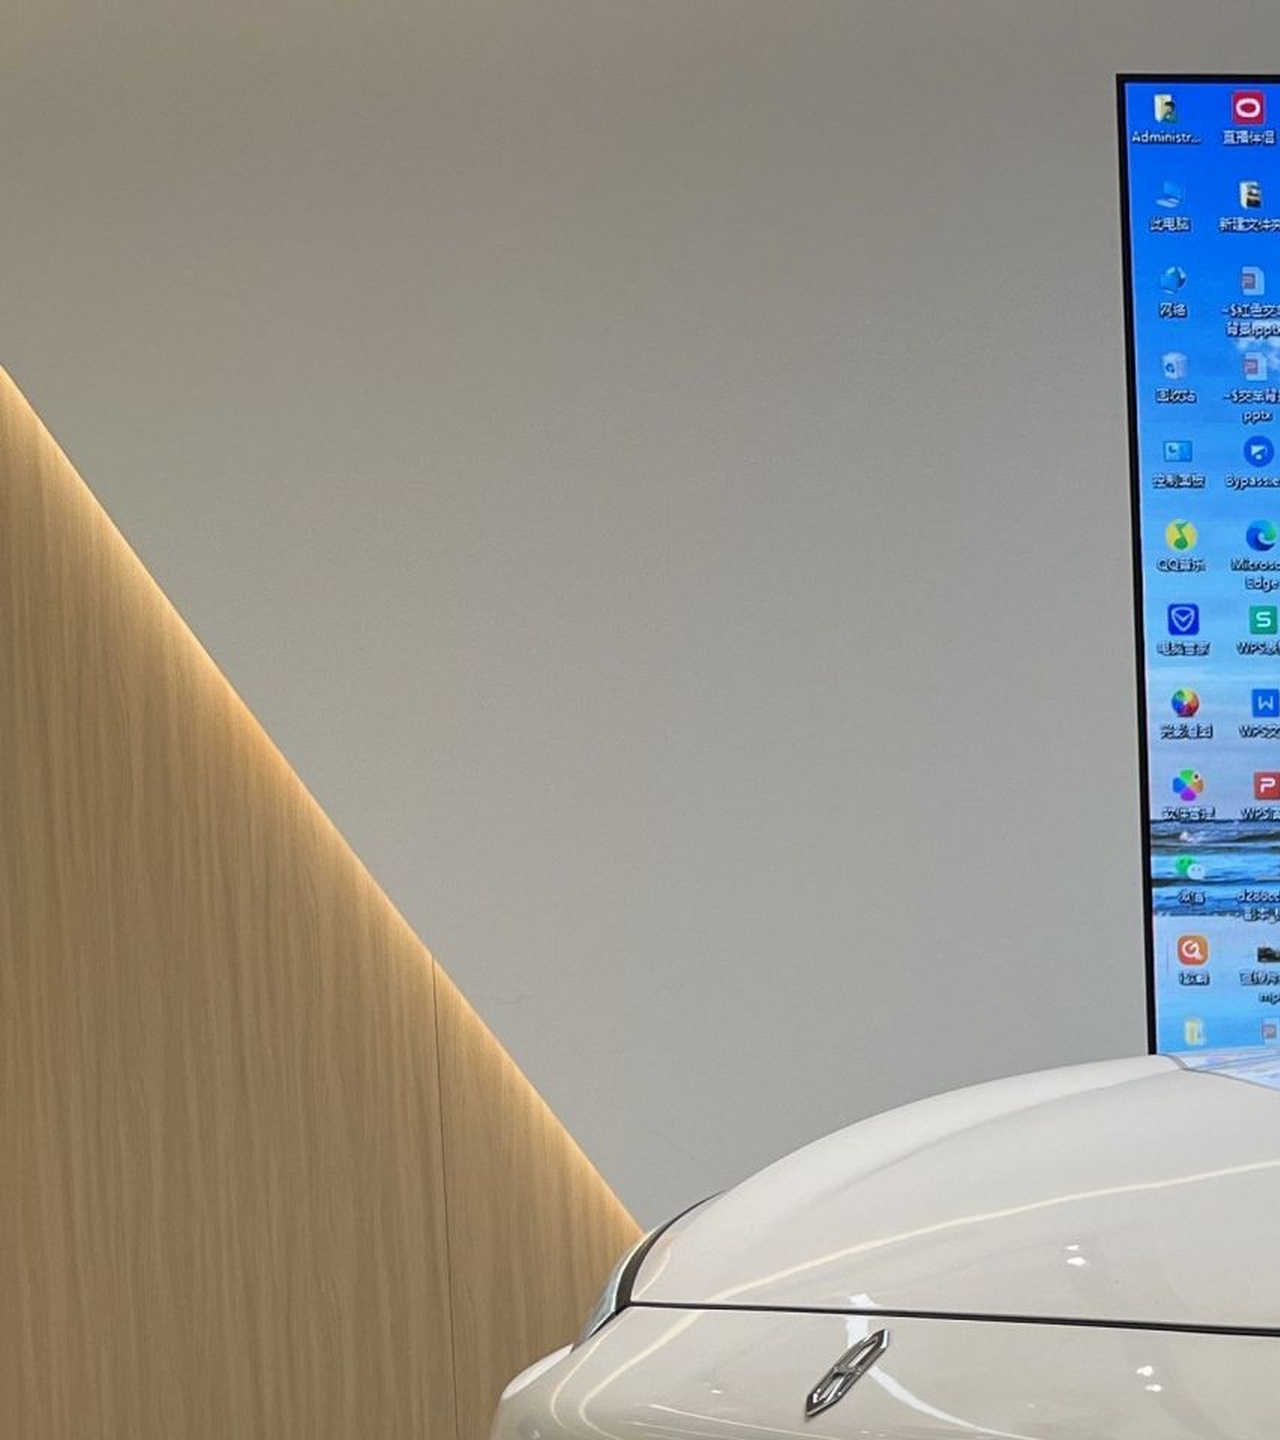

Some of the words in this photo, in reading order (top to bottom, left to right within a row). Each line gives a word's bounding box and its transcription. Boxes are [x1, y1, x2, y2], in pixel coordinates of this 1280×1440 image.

[1223, 130, 1276, 144] 直播伴侣
[1150, 217, 1190, 231] 此电脑
[1160, 302, 1187, 317] 网络
[1156, 389, 1196, 402] 回收站
[1157, 558, 1206, 572] QQ音乐
[1245, 576, 1280, 592] Edge
